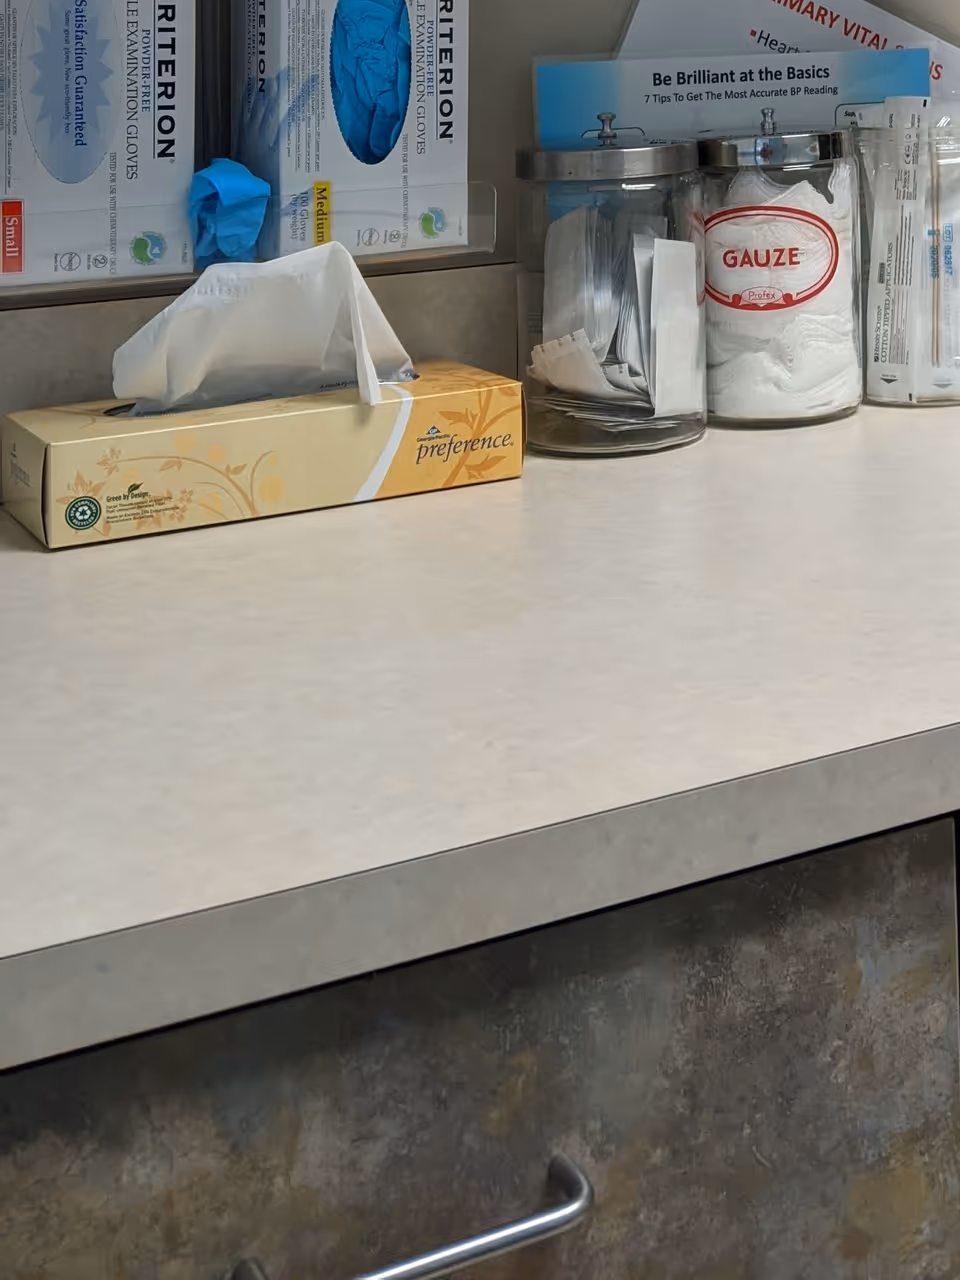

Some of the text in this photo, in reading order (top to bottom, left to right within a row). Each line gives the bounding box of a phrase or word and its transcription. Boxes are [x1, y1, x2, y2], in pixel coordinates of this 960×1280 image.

[62, 29, 71, 45] great
[74, 0, 88, 147] Satisfaction Guaranteed
[126, 20, 139, 120] EXAMINATION
[141, 29, 151, 113] POWDER-FREE
[415, 12, 425, 103] EXAMINATION
[425, 20, 434, 97] POWDER-FREE
[653, 65, 830, 86] Be Brilliant at the Basics
[62, 84, 71, 121] eco-friendly
[644, 85, 838, 105] 7 Tips To Get The Most Accurate BP Reading
[415, 105, 425, 155] GLOVES
[109, 151, 117, 172] TESTED
[126, 121, 139, 181] GLOVES
[289, 194, 299, 240] (by weight)
[300, 192, 308, 241] 100 Gloves
[316, 187, 327, 242] Medium
[5, 217, 19, 257] Small
[722, 247, 801, 268] GAUZE
[884, 242, 893, 297] APPLICATORS
[748, 290, 776, 301] Profex
[883, 299, 891, 327] TIPPED
[881, 328, 889, 363] COTTON
[415, 433, 512, 465] preference
[106, 491, 149, 503] Green by Design
